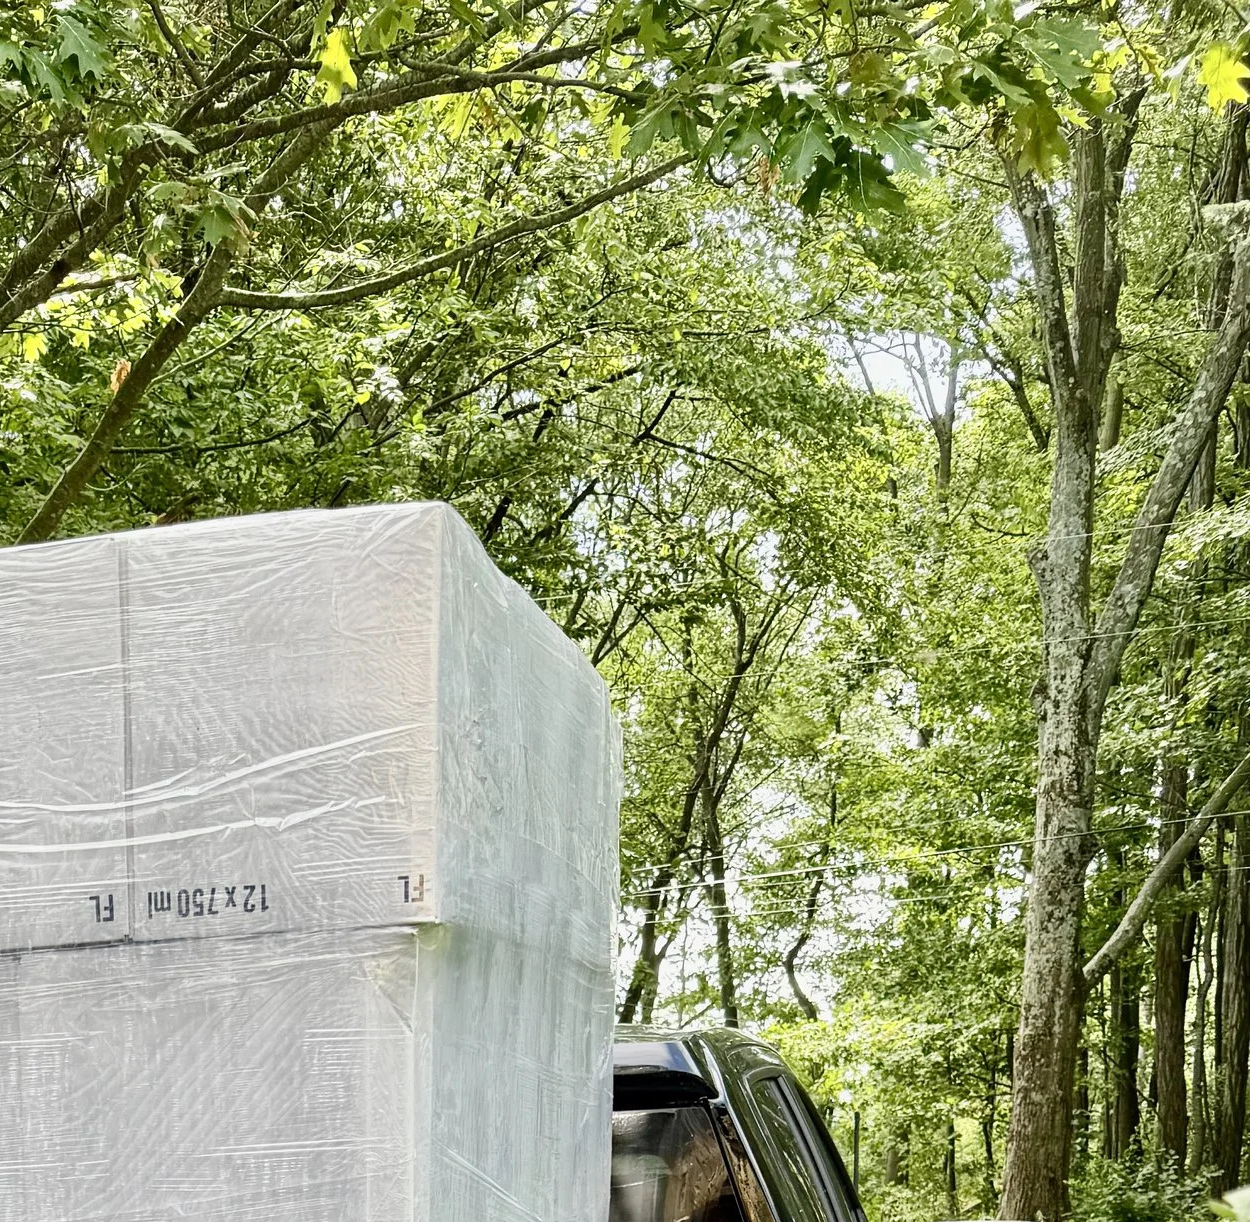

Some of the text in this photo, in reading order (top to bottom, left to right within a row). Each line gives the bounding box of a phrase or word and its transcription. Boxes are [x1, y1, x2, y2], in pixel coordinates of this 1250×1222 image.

[177, 888, 219, 917] 750
[243, 884, 269, 912] 12
[397, 873, 425, 903] FL
[89, 894, 114, 923] FL
[148, 890, 171, 919] ml
